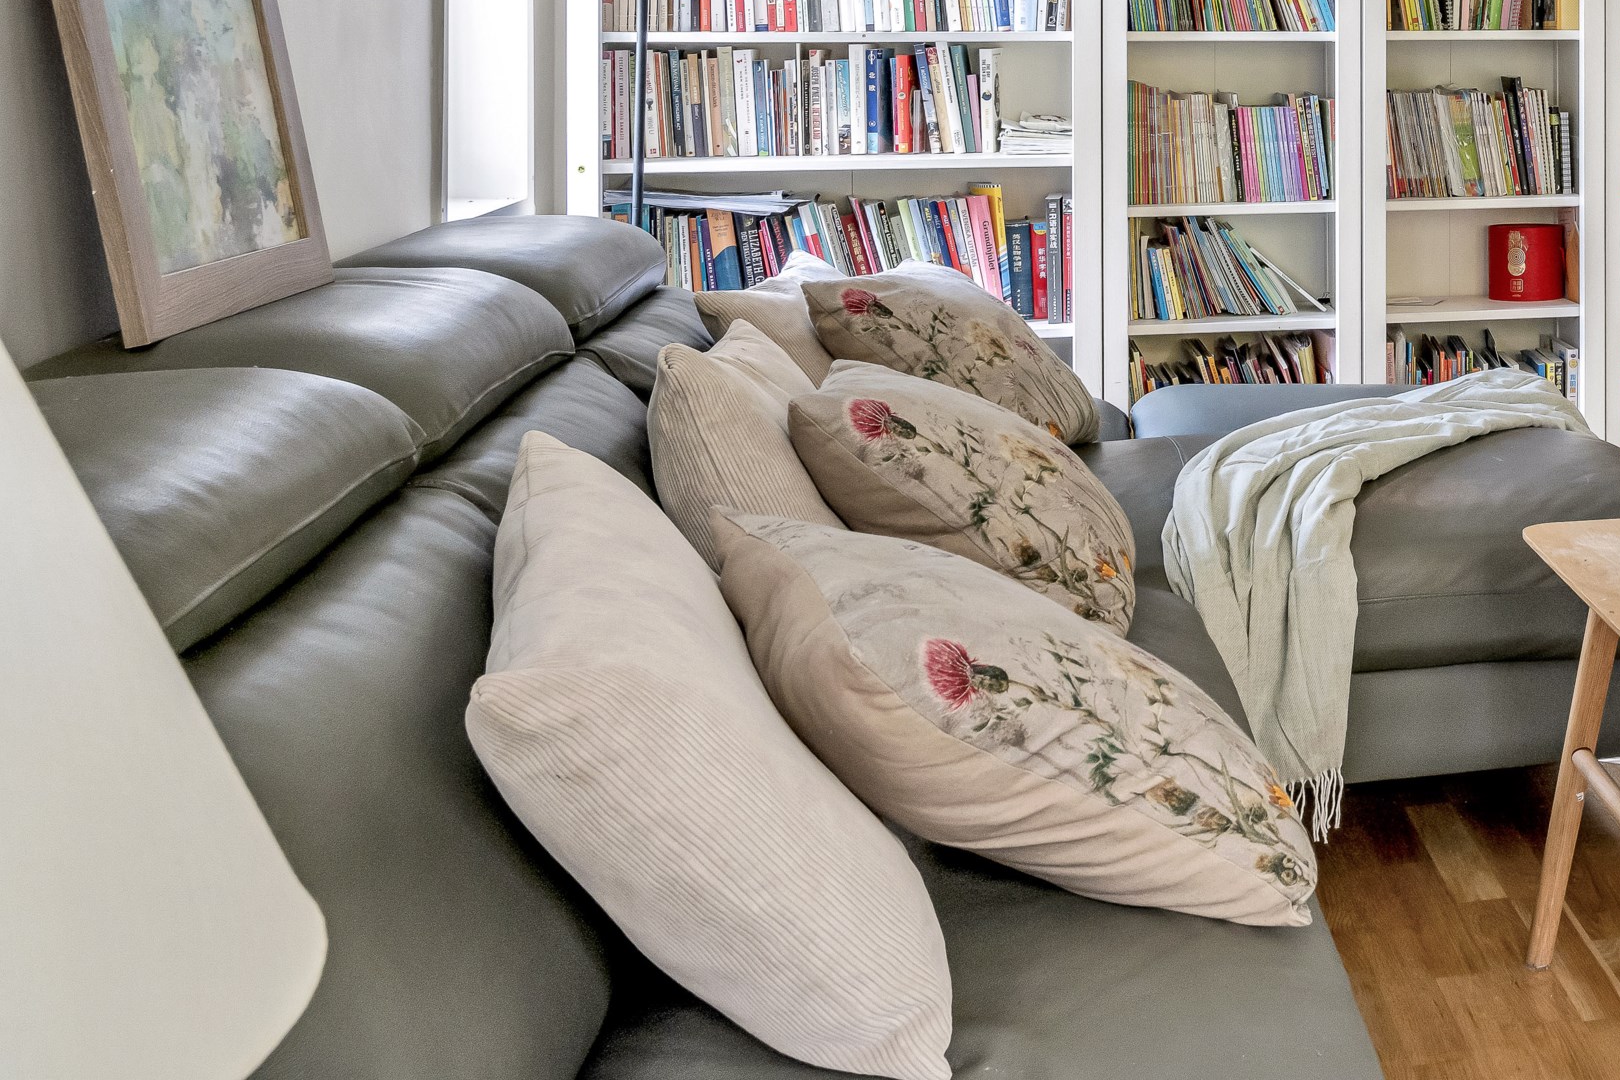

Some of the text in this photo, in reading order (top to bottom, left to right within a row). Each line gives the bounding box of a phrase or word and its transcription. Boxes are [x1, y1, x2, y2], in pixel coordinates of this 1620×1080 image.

[962, 209, 971, 238] SVENSKA
[749, 229, 762, 273] ELIZABETH
[982, 220, 995, 271] Grundhjulet
[746, 266, 755, 287] BROTTSL
[1037, 247, 1047, 279] 新华字典
